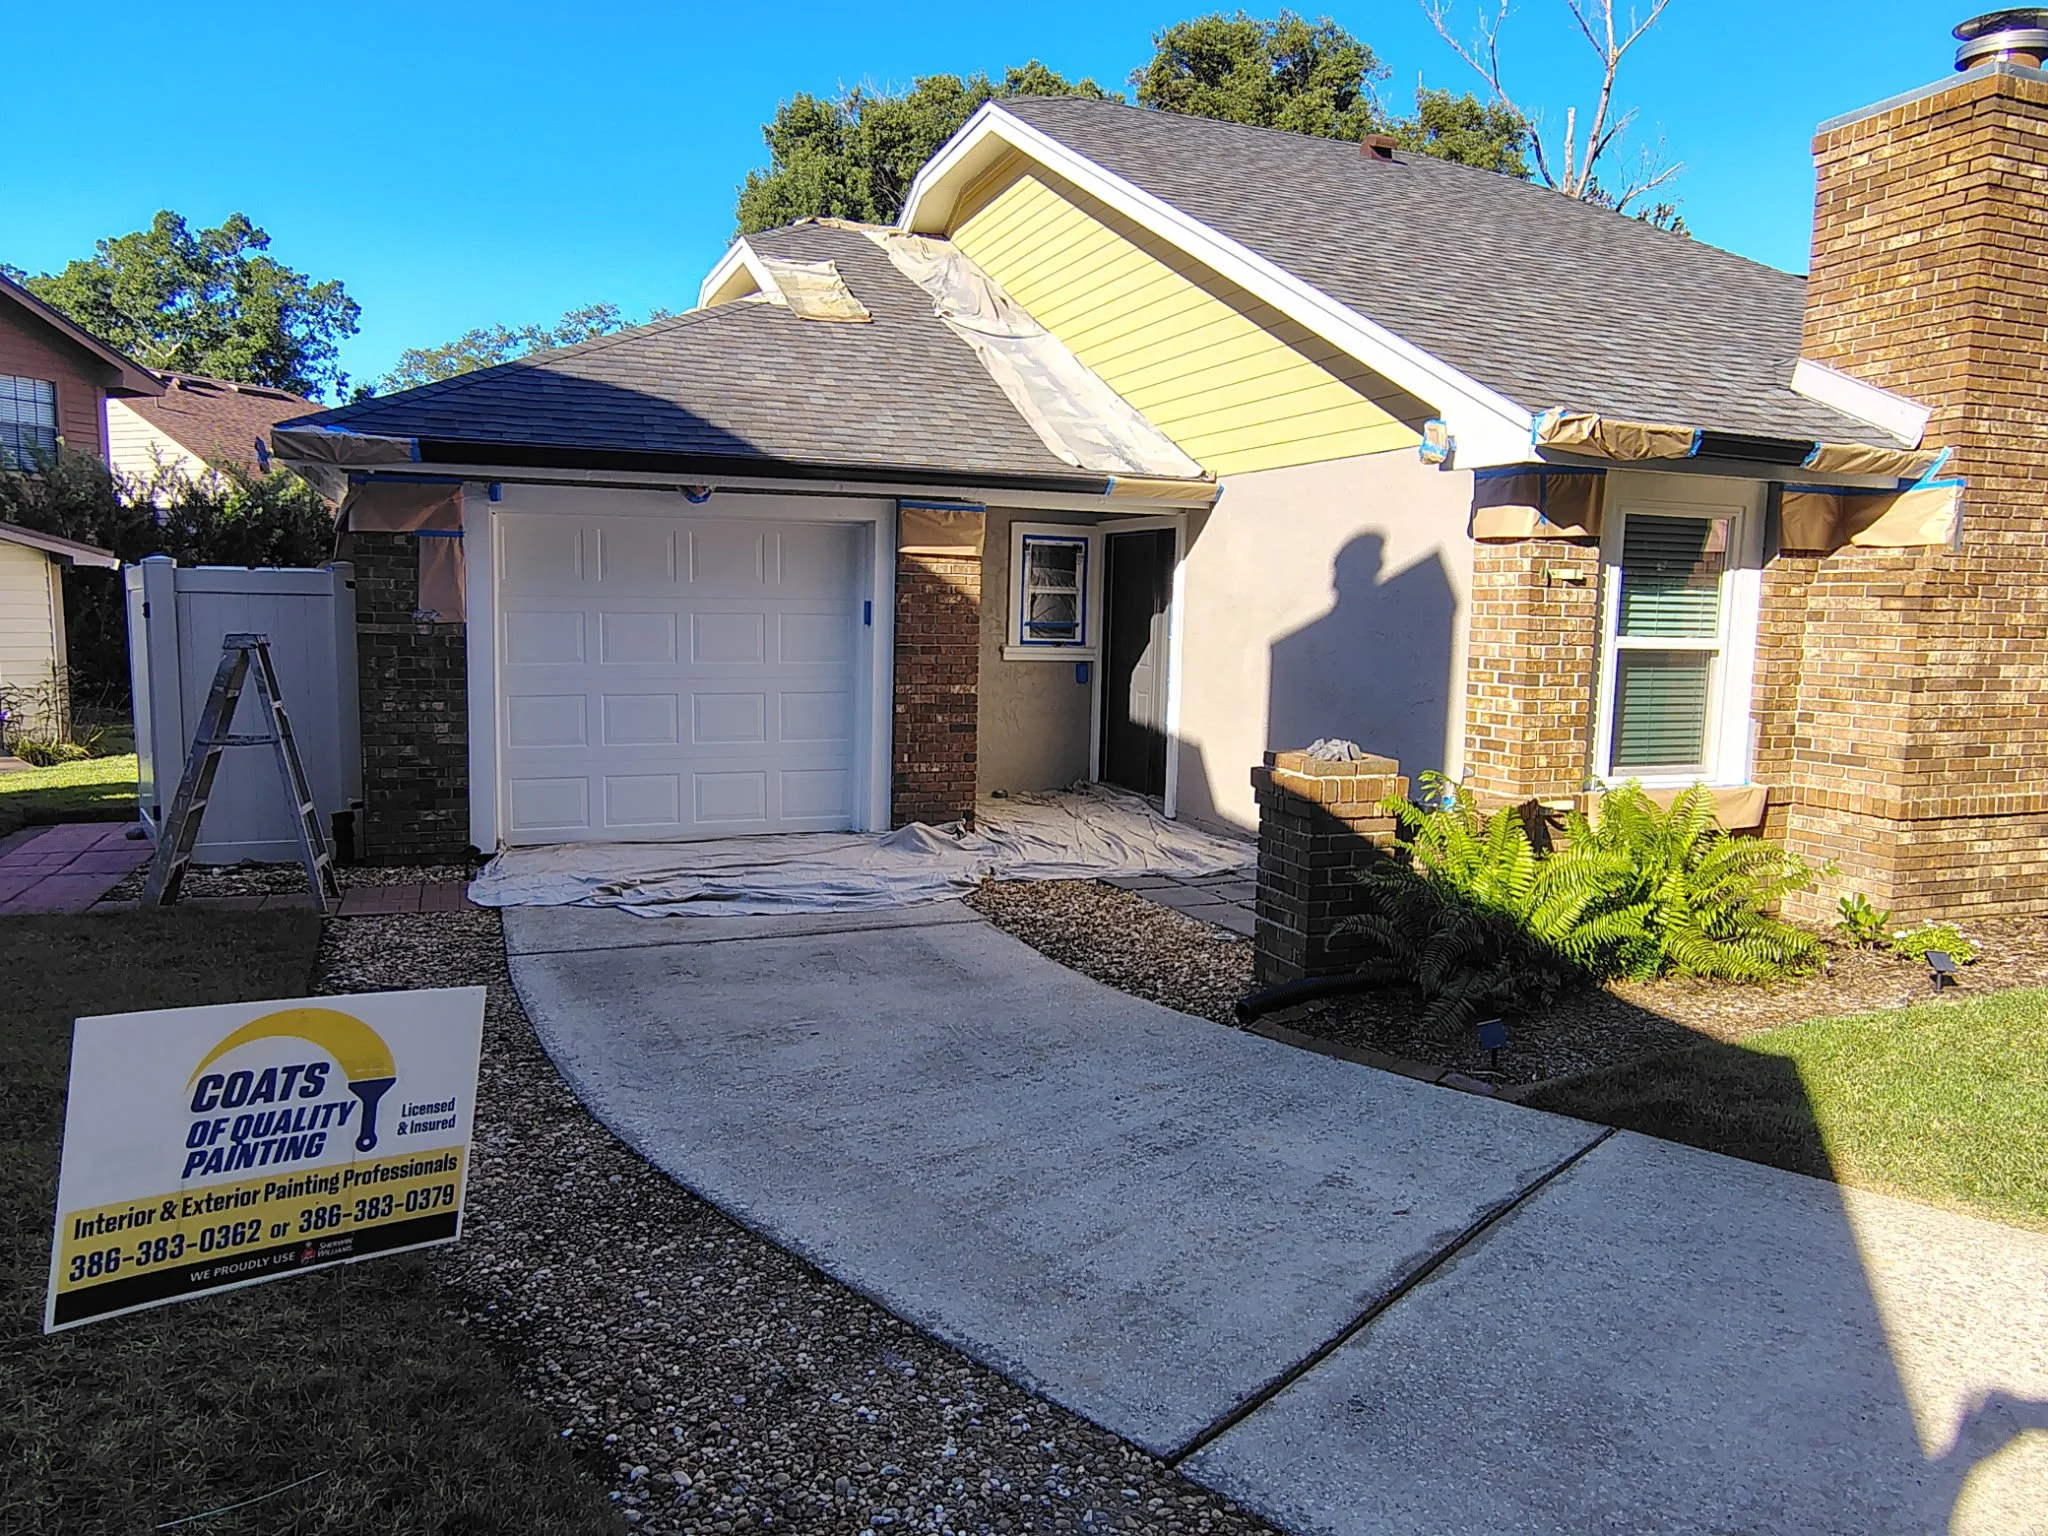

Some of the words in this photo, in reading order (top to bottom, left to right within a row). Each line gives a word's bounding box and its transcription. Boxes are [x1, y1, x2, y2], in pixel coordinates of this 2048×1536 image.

[190, 1062, 331, 1113] COATS
[401, 1098, 456, 1118] Licensed
[185, 1116, 230, 1149] OF
[230, 1100, 358, 1146] QUALITY
[397, 1121, 408, 1136] &
[410, 1114, 456, 1135] Insured
[181, 1132, 328, 1179] PAINTING
[74, 1206, 157, 1241] Interior
[159, 1200, 180, 1222] &
[181, 1187, 261, 1219] Exterior
[264, 1172, 340, 1203] Painting
[343, 1152, 458, 1188] Professionals
[69, 1218, 262, 1283] 386-383-0362
[270, 1220, 290, 1239] or
[299, 1183, 456, 1234] 386-383-0379
[190, 1269, 211, 1282] WE
[213, 1256, 270, 1278] PROUDLY
[273, 1251, 296, 1265] USE
